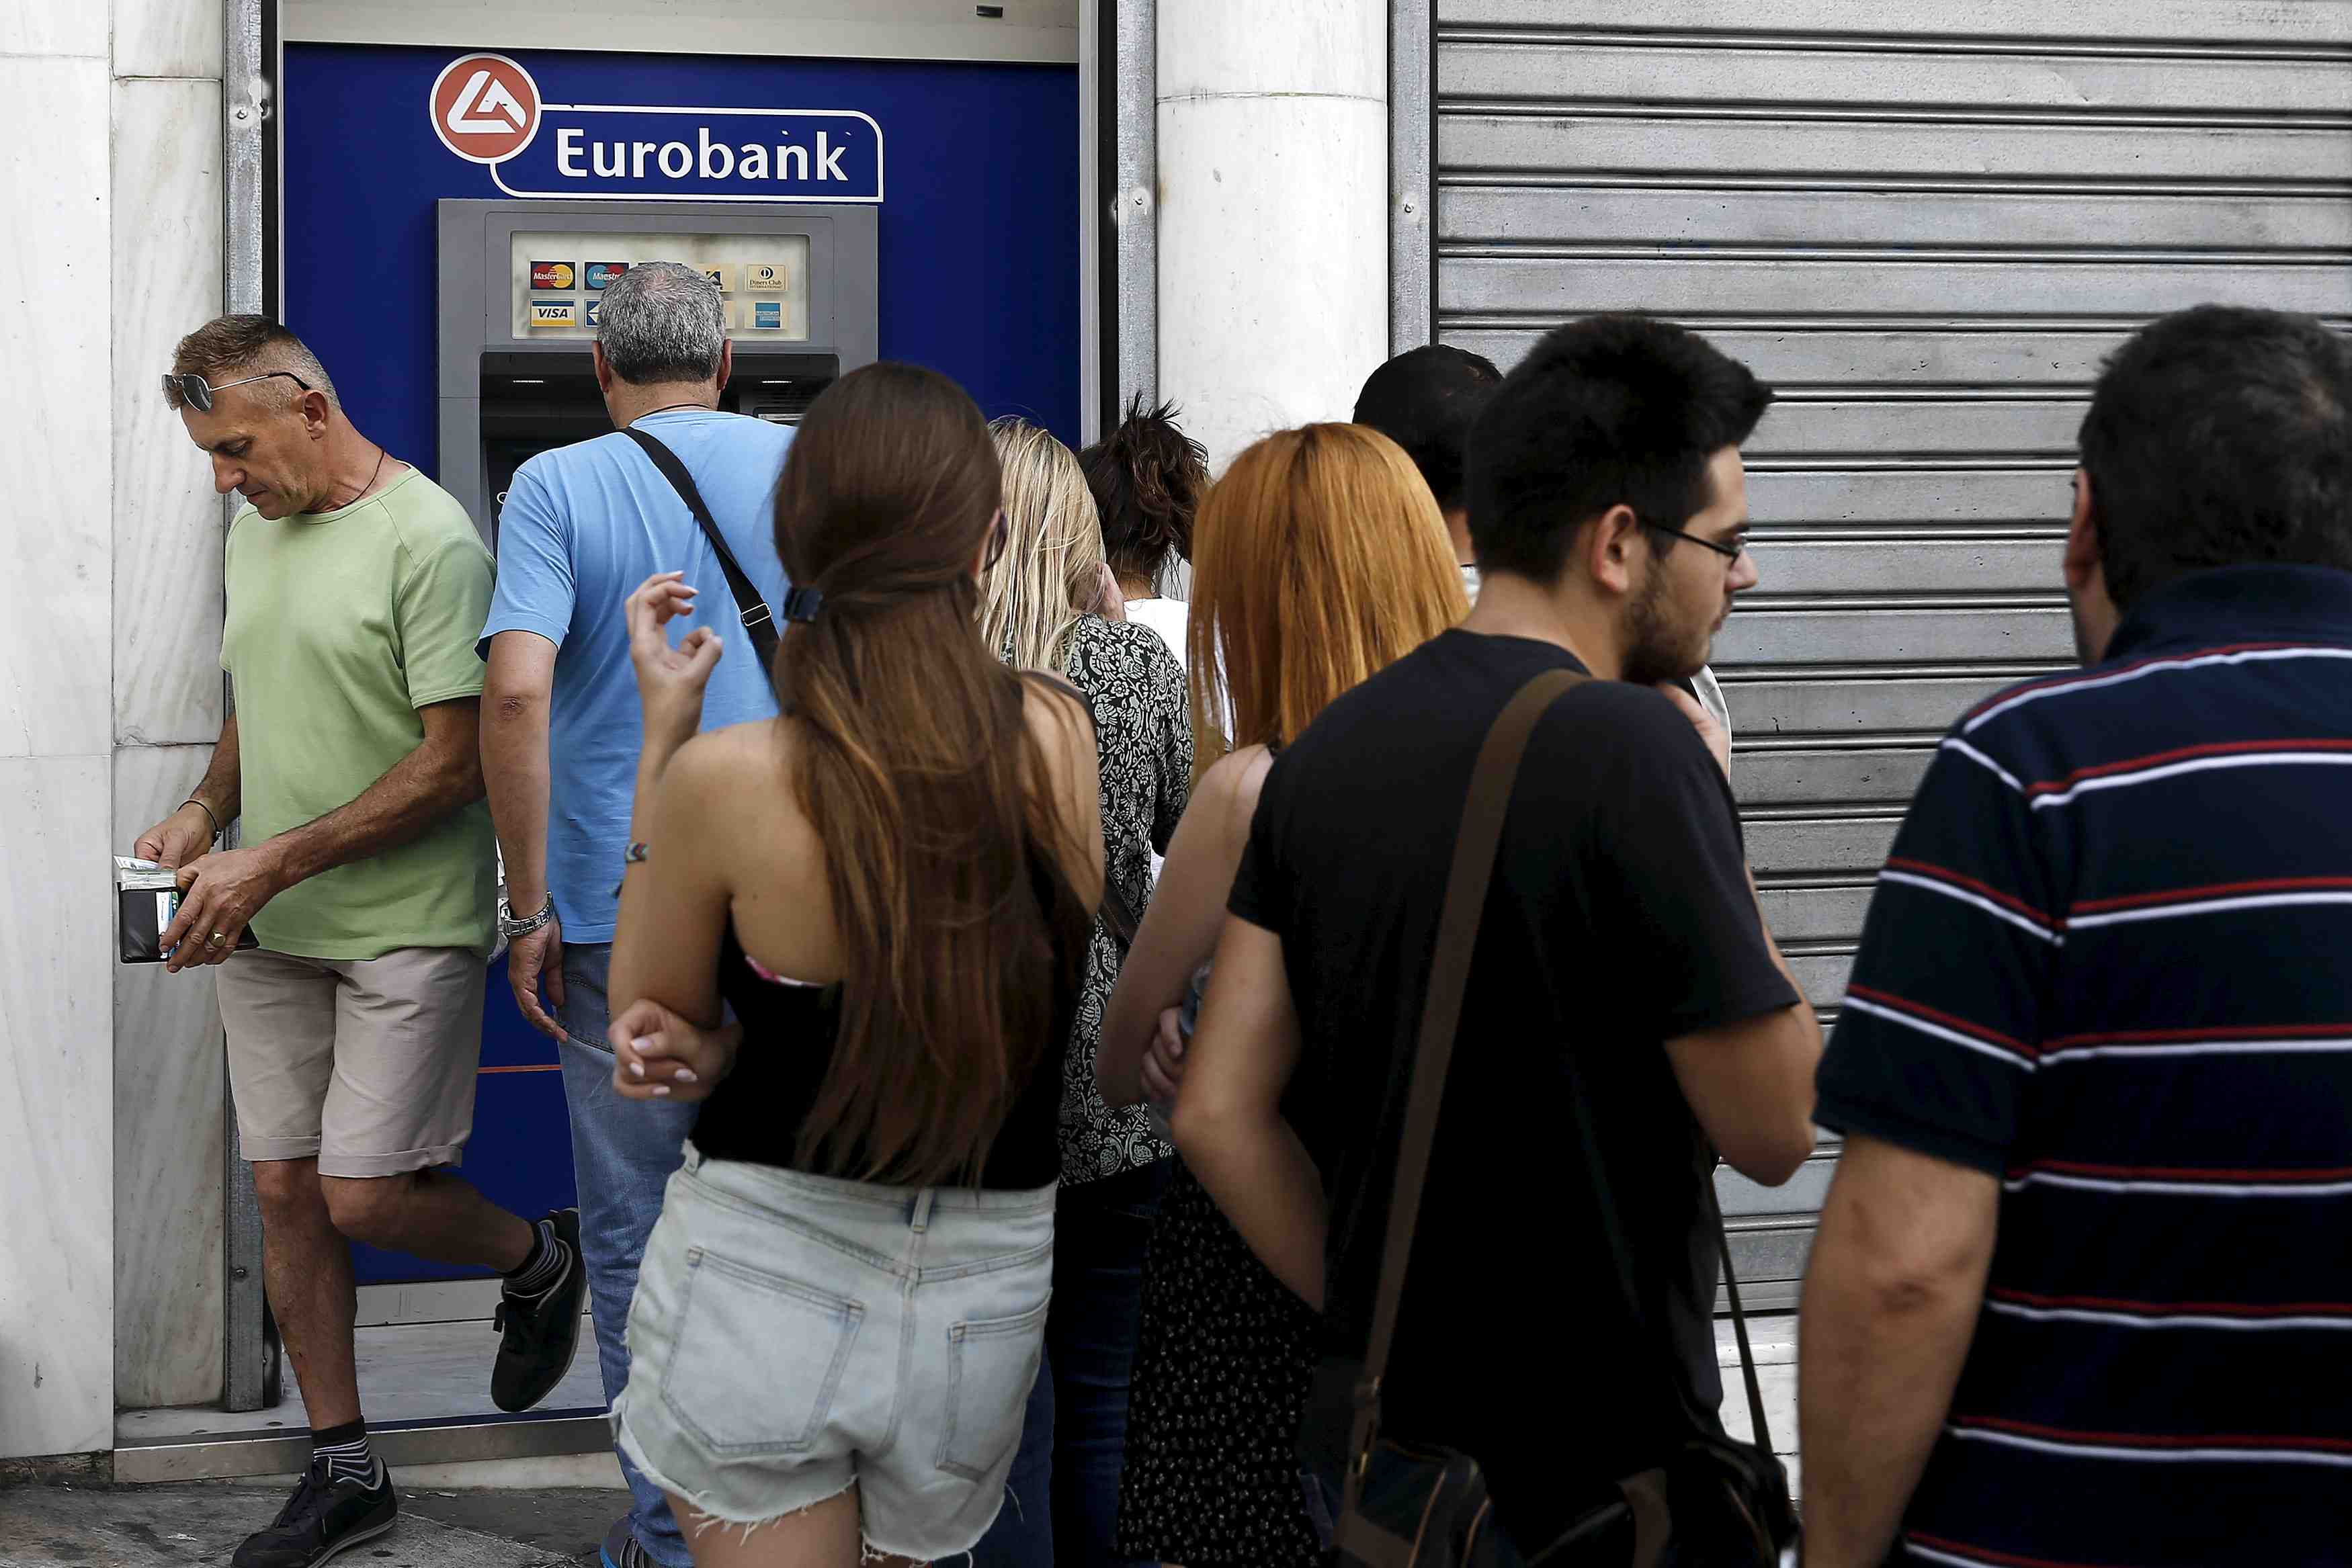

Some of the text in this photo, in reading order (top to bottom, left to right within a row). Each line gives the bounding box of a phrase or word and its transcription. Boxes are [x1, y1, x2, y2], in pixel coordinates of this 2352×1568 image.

[556, 128, 849, 181] Eurobank
[592, 272, 621, 280] Maestr
[539, 308, 569, 318] VISA
